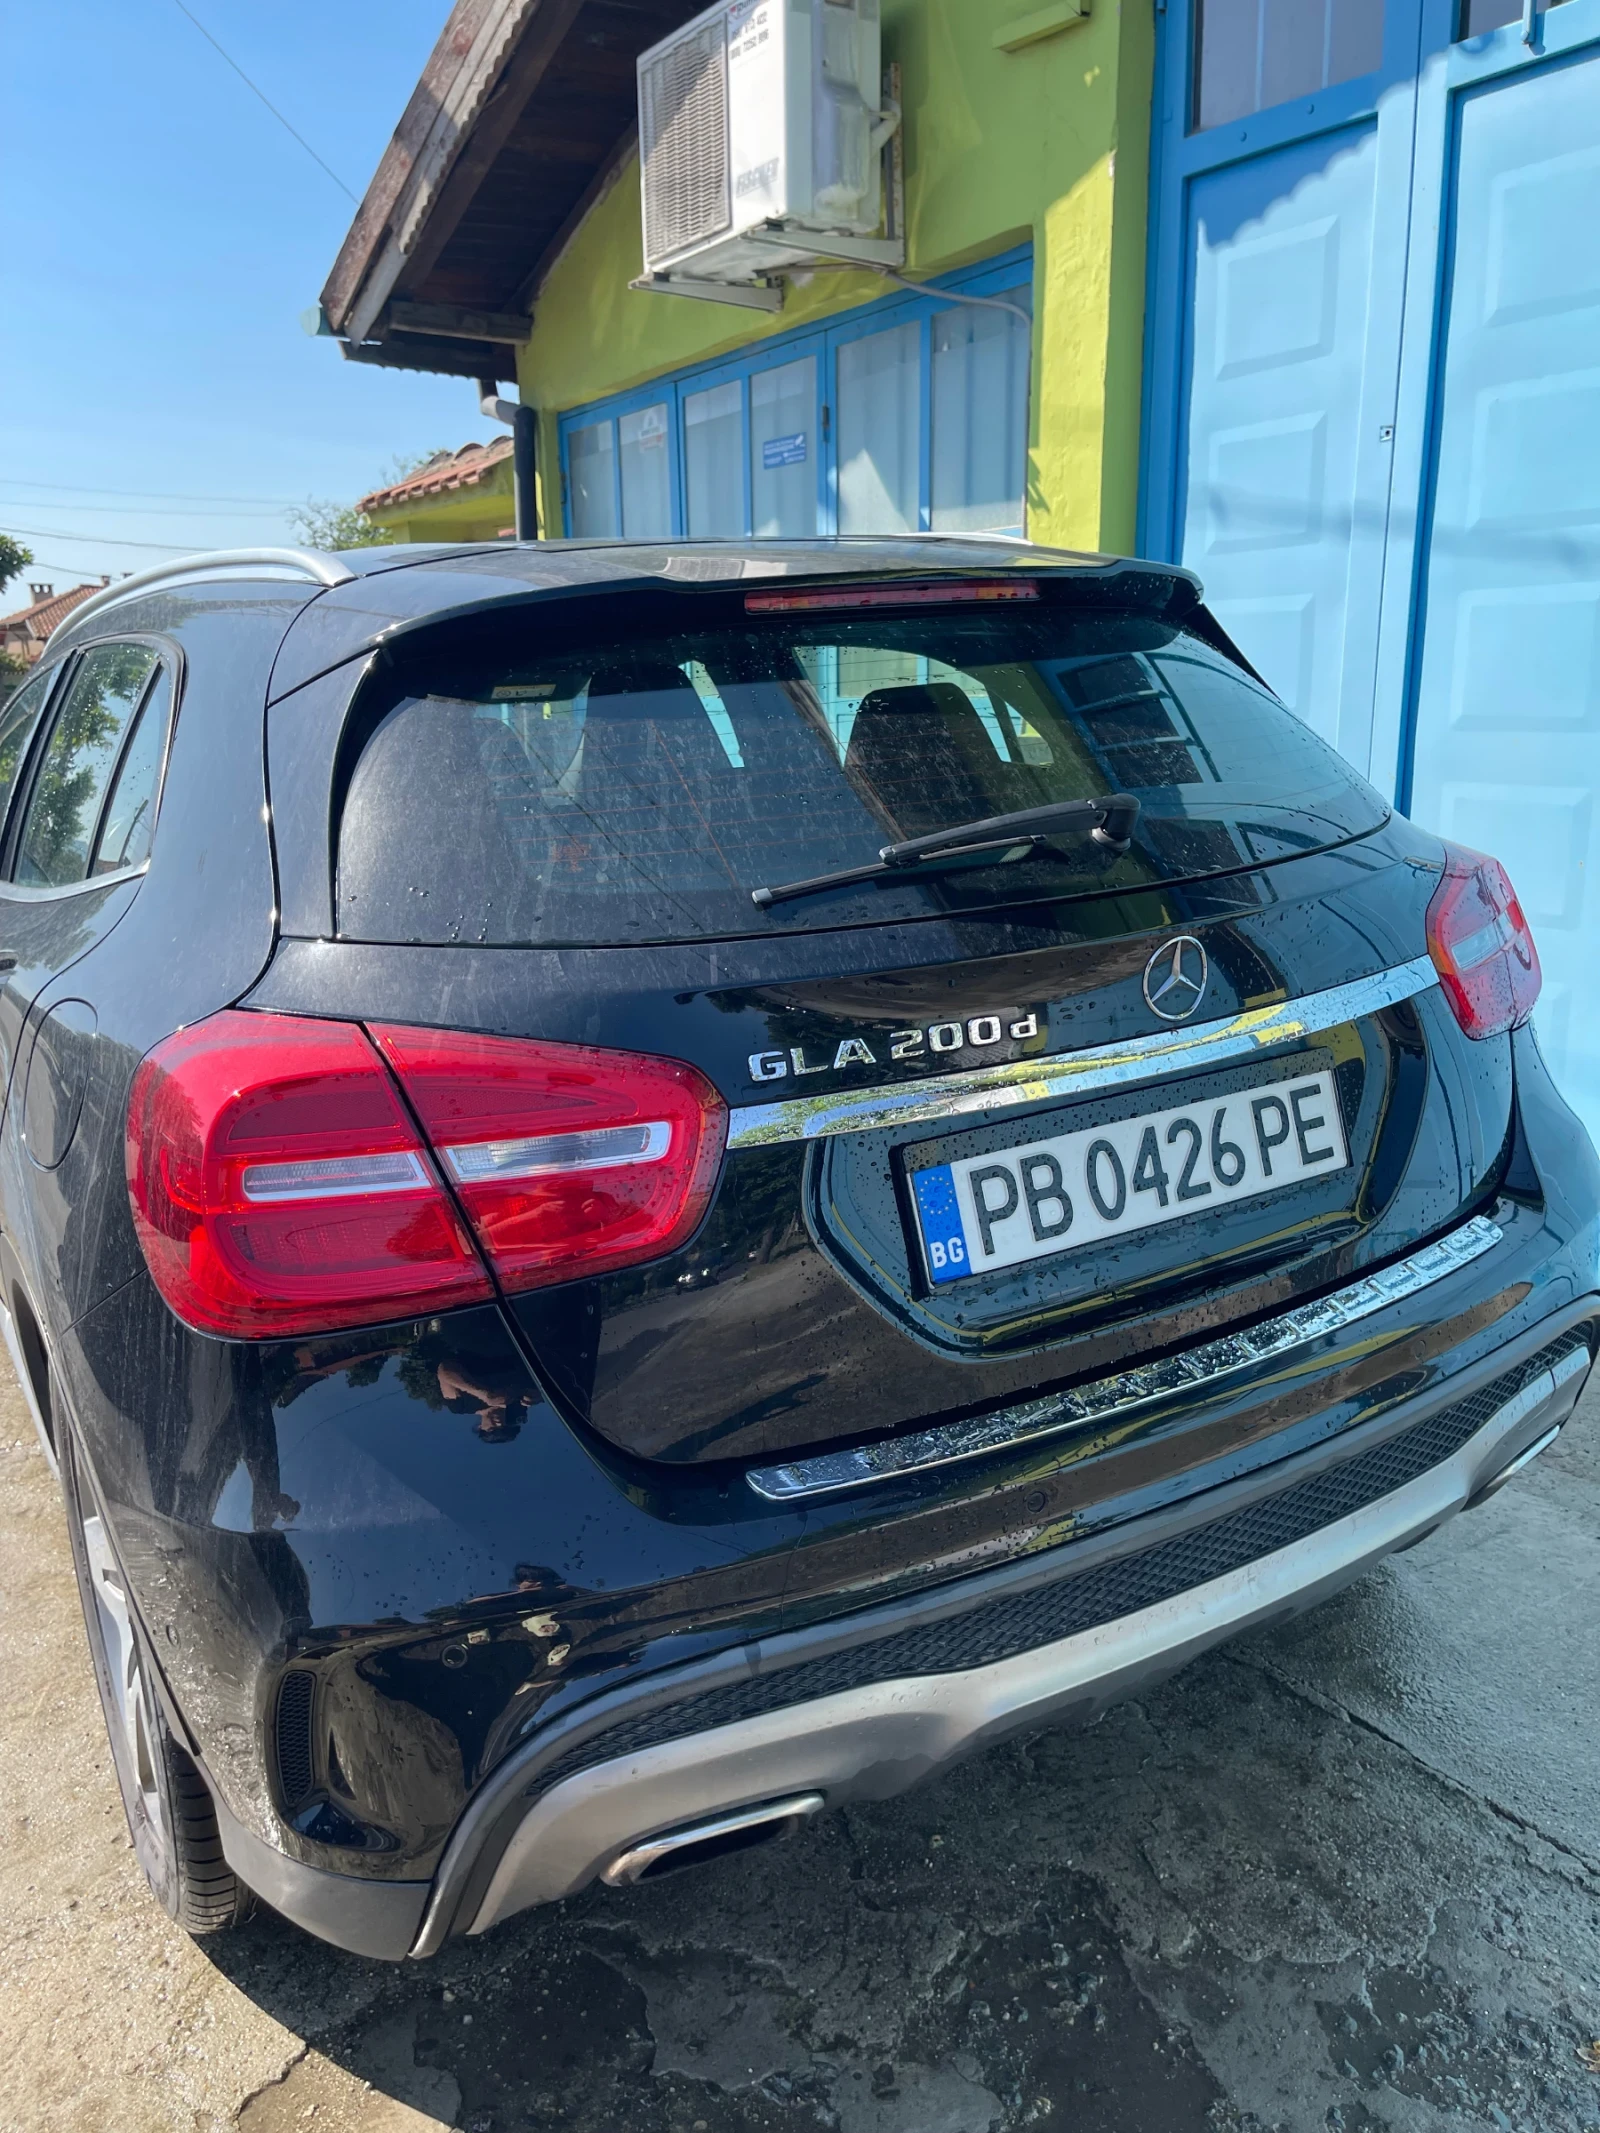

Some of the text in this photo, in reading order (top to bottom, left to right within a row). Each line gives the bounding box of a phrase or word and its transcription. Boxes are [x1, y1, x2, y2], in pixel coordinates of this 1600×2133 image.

[748, 1038, 876, 1082] GLA
[969, 1083, 1335, 1256] PB 0426 PE
[929, 1236, 966, 1269] BG
